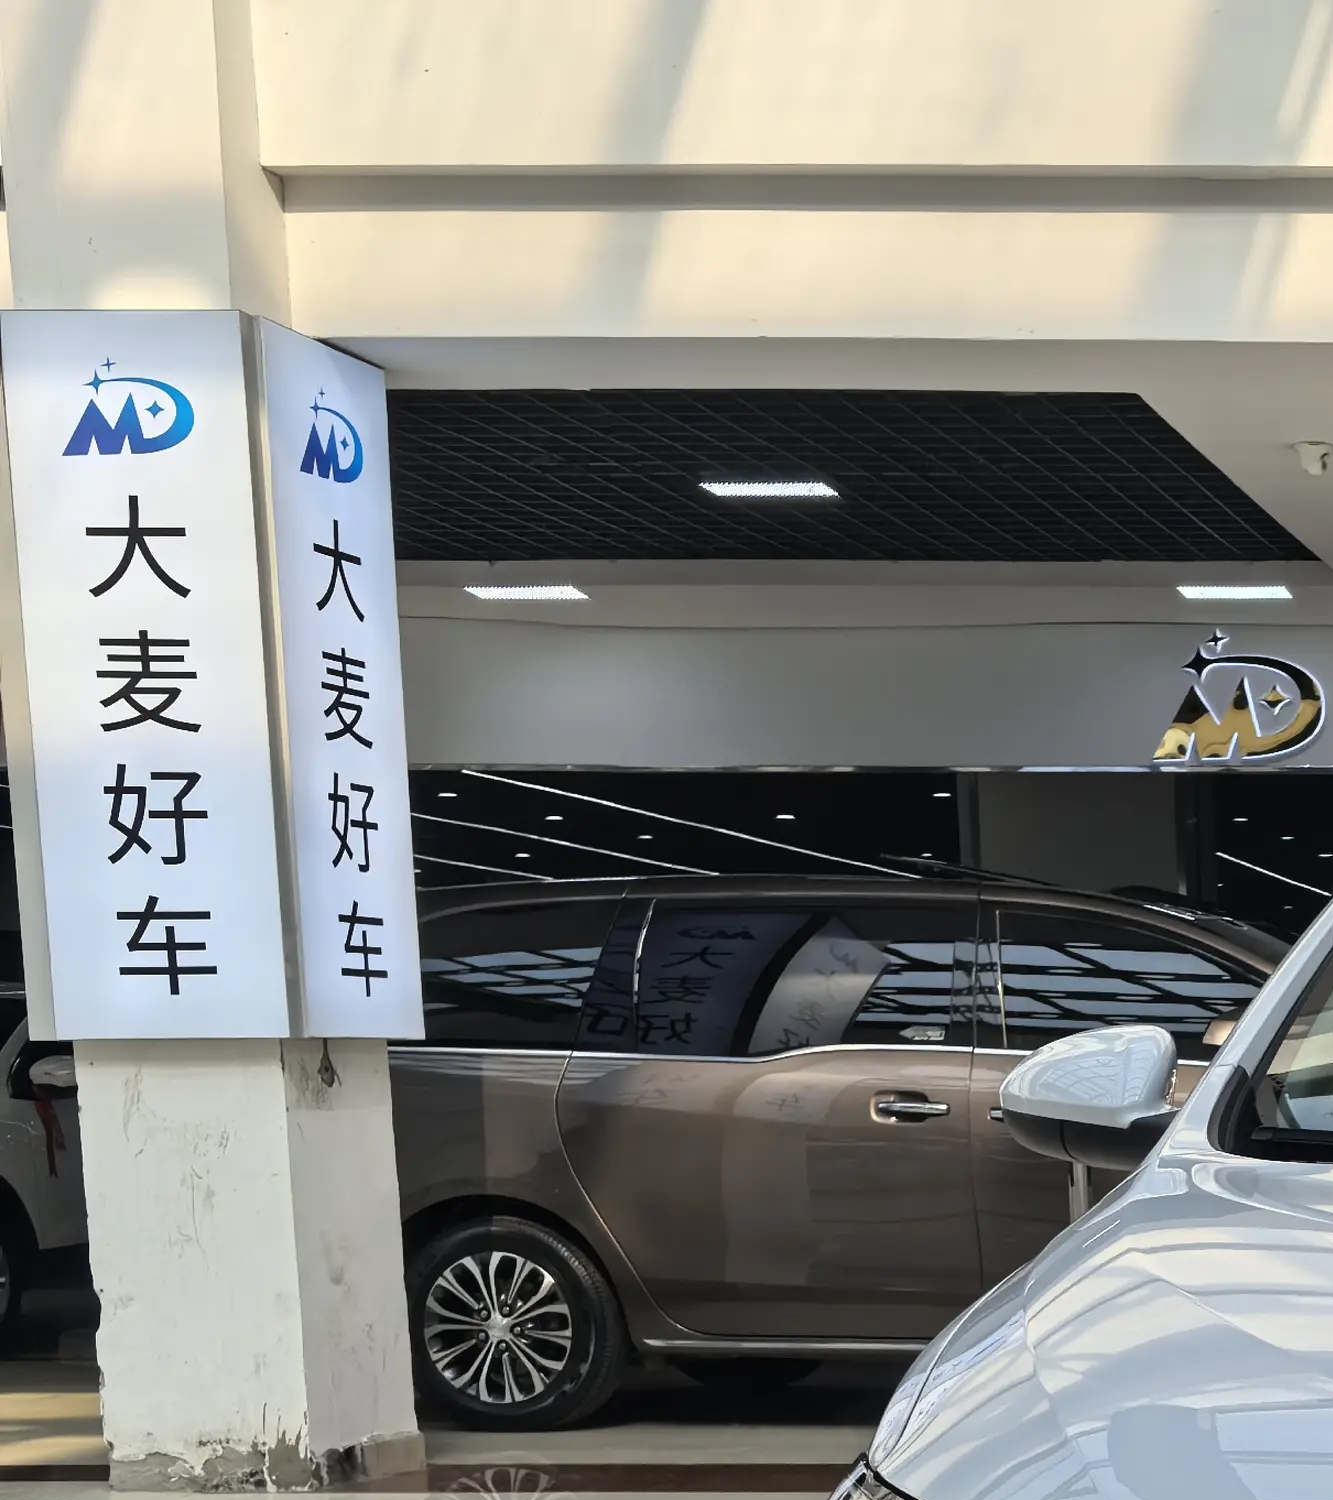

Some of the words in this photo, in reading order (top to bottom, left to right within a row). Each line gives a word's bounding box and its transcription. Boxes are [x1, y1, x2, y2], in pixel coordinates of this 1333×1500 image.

[86, 496, 218, 996] 大麦好车
[313, 519, 388, 998] 大麦好车
